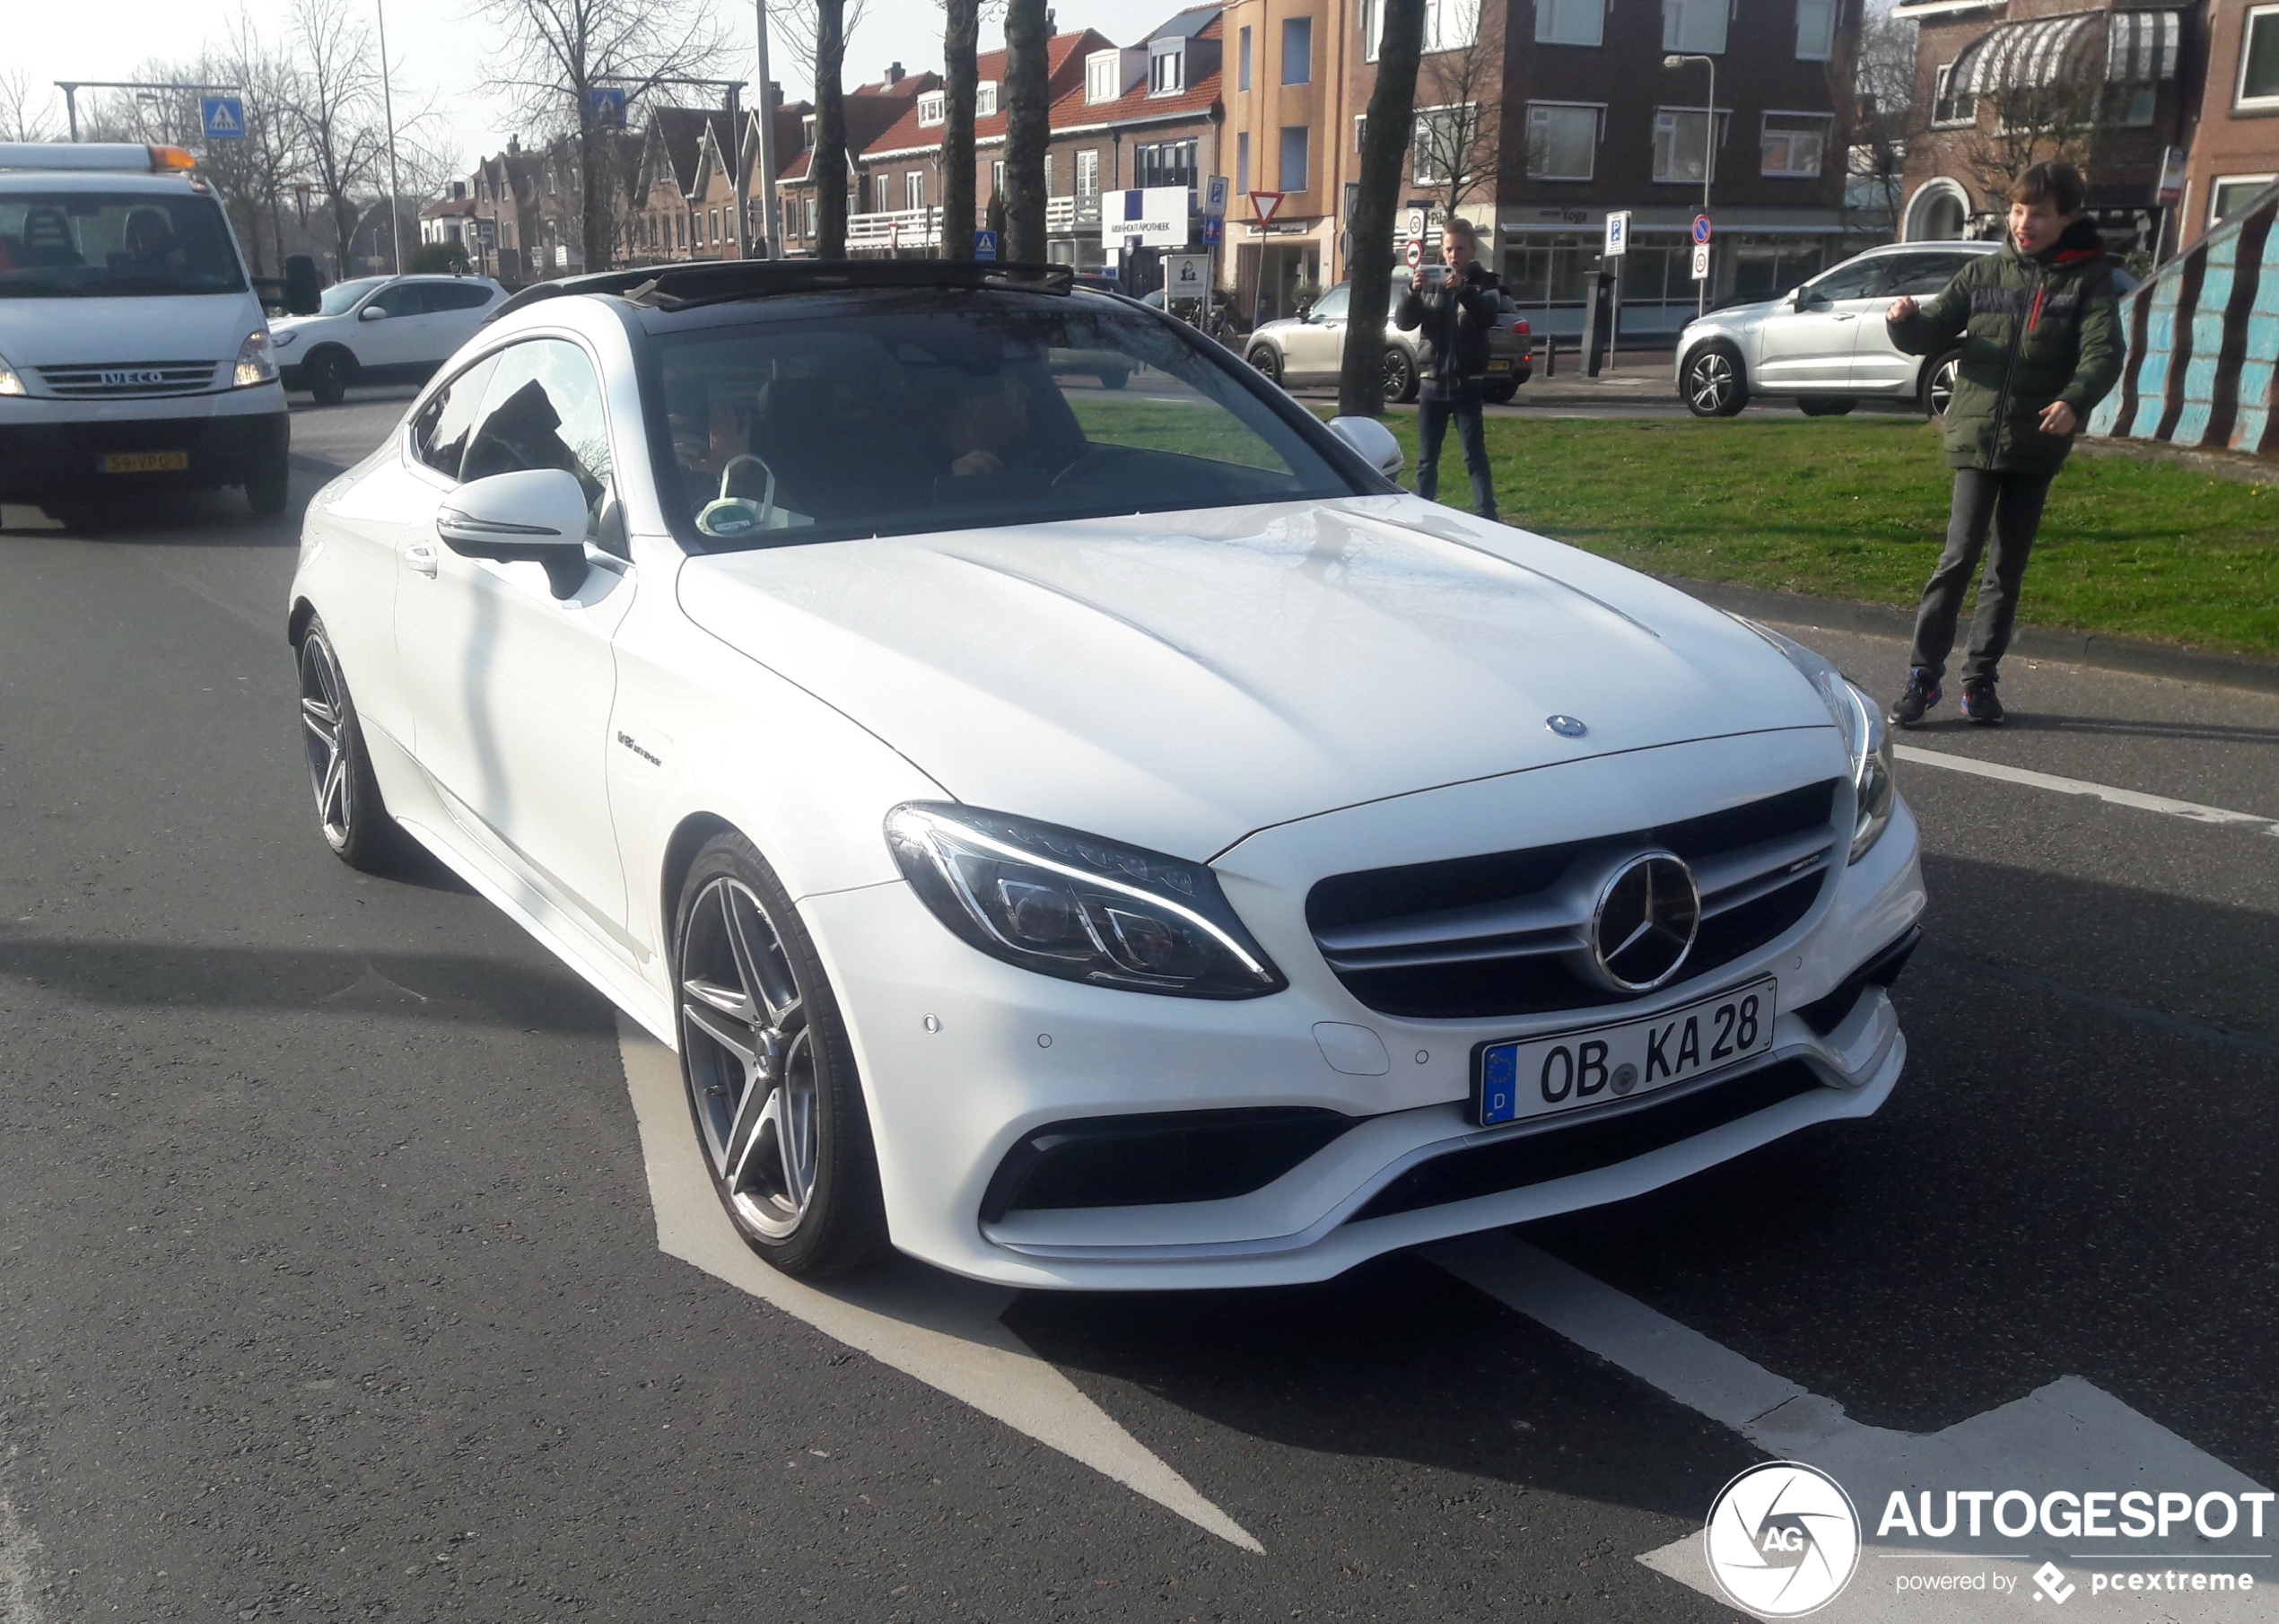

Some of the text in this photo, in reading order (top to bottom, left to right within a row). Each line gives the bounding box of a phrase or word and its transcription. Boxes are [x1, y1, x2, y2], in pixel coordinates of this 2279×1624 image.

[1562, 206, 1587, 224] Yoga
[1139, 222, 1170, 231] APOTHEEK
[1411, 221, 1419, 229] 30
[100, 371, 162, 385] IVECO
[1541, 1039, 1609, 1104] OB
[1494, 1093, 1505, 1109] D
